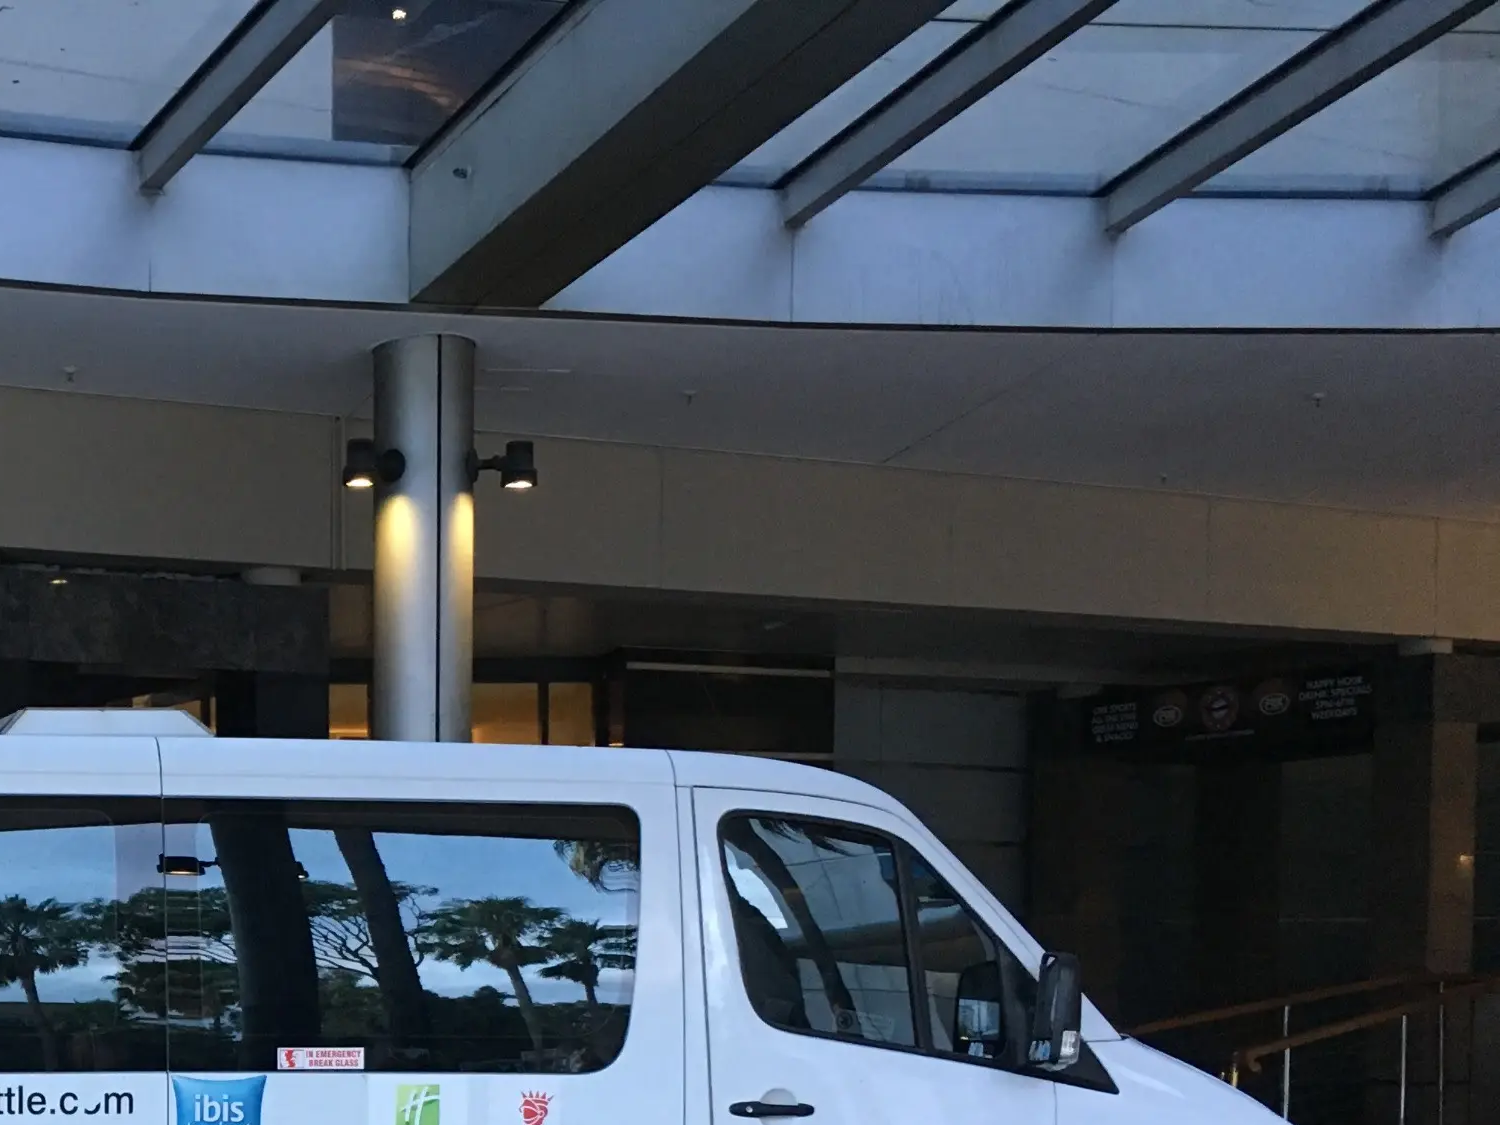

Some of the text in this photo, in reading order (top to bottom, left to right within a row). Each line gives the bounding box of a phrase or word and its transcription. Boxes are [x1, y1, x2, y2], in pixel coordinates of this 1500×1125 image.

[306, 1050, 361, 1058] IN EMERGENCY
[309, 1059, 359, 1067] BREAK GLASS
[194, 1094, 245, 1123] ibis
